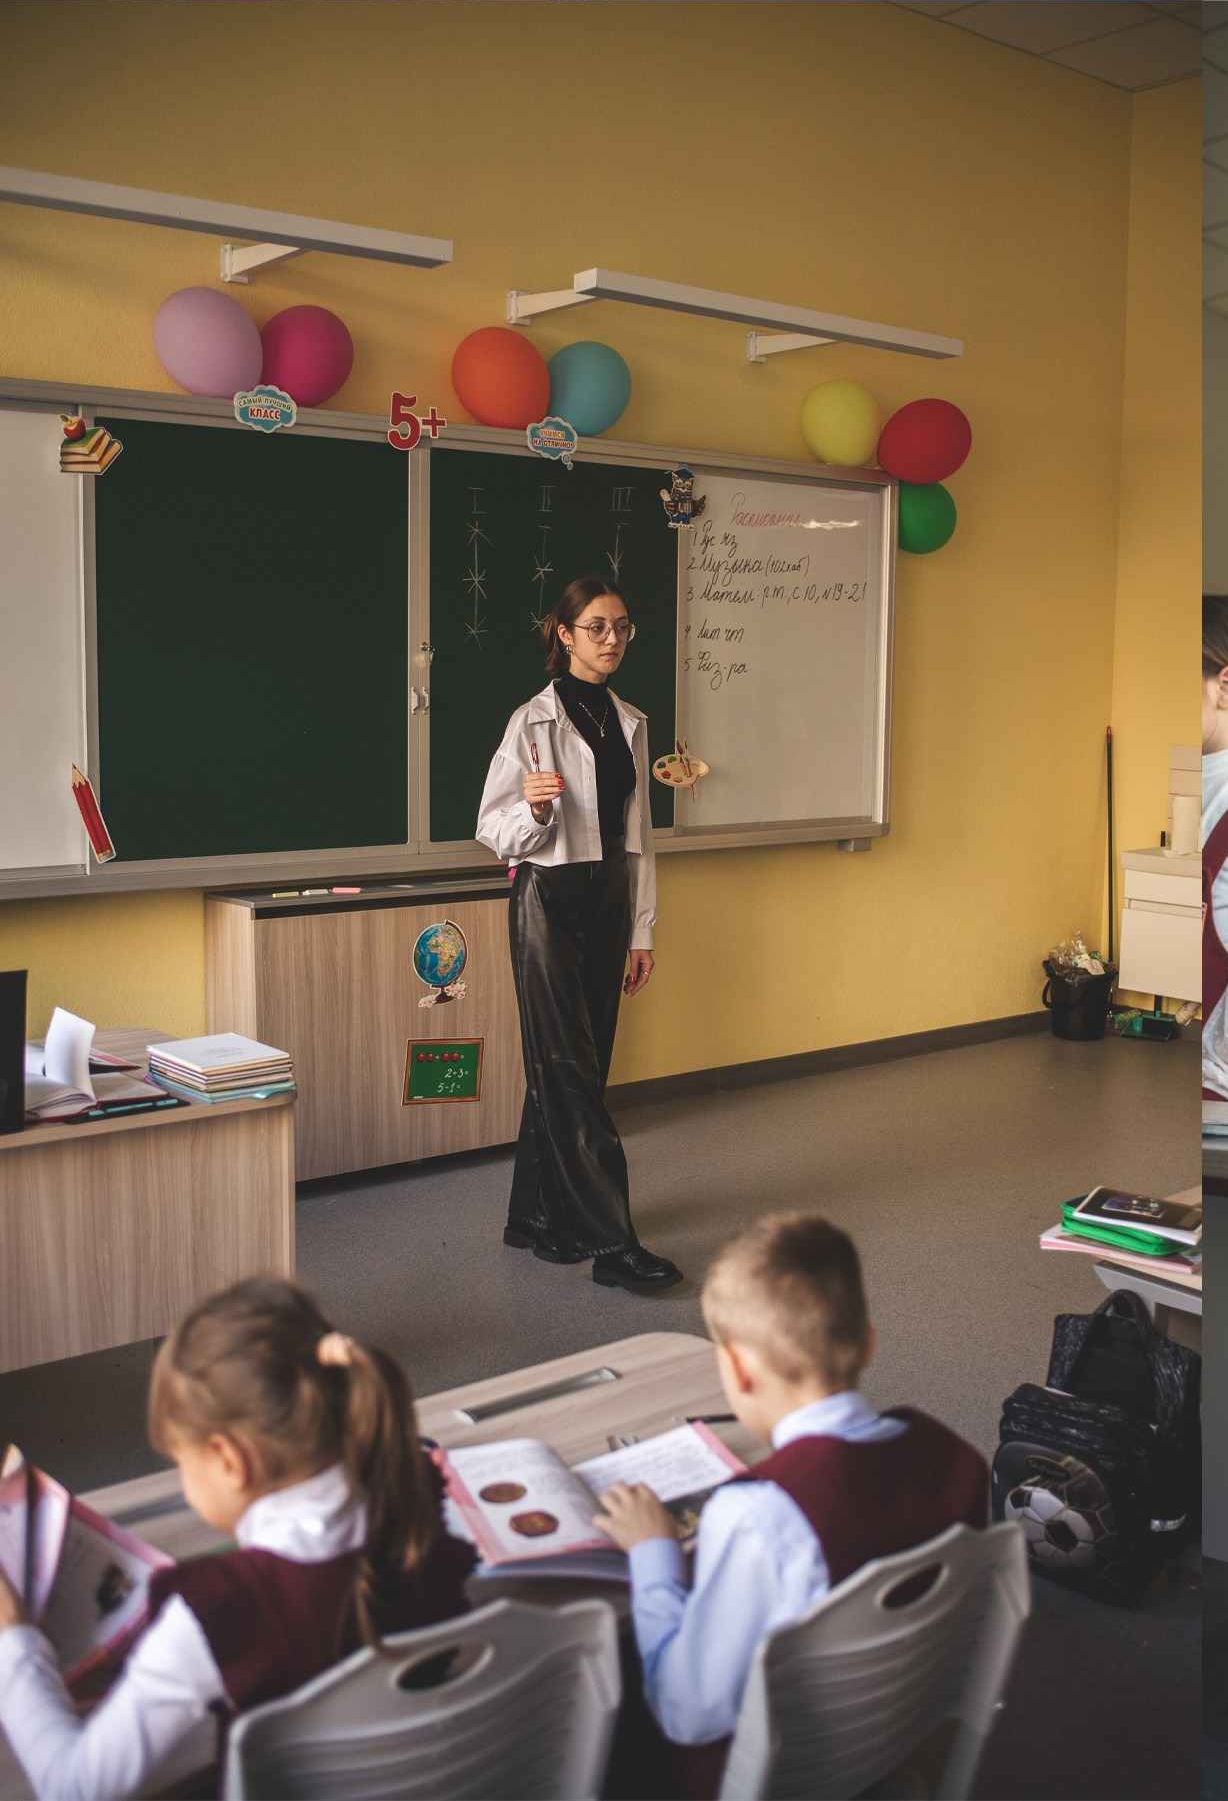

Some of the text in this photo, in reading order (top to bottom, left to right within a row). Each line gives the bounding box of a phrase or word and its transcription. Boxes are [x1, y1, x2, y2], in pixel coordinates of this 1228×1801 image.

[239, 396, 292, 412] САМЫЙ ЛУЧШИЙ
[249, 407, 280, 420] КЛАСС
[388, 392, 446, 449] 5+
[540, 430, 565, 439] УЧИМСЯ
[533, 439, 573, 449] НА ОТЛИЧНО!
[730, 492, 803, 528] Расписани
[699, 553, 764, 587] Музыка
